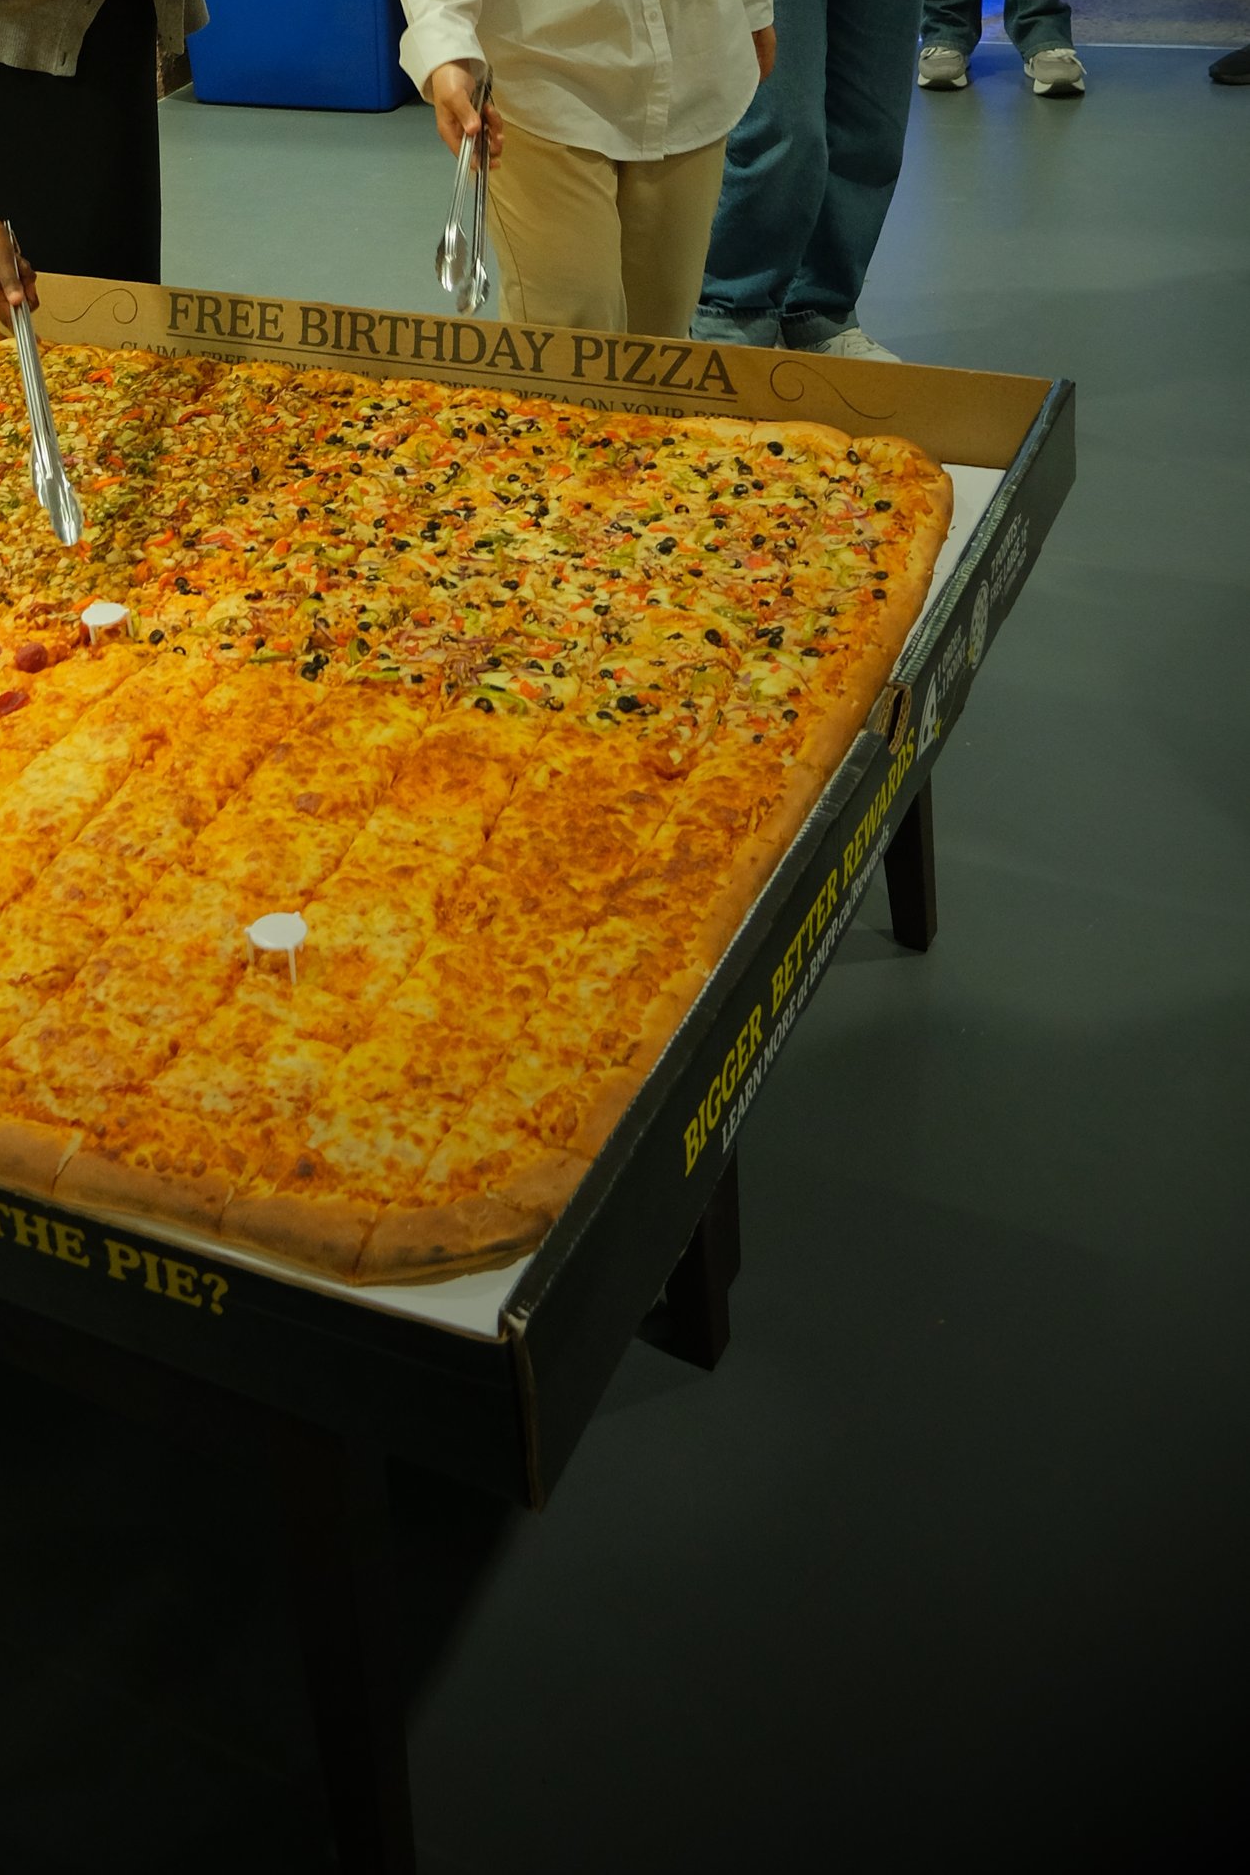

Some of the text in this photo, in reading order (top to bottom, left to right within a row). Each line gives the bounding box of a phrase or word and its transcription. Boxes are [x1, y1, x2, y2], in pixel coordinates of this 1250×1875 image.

[168, 291, 740, 396] FREE BIRTHDAY PIZZA
[682, 726, 916, 1178] BIGGER BETTER REWARDS
[721, 1059, 762, 1155] LEARN
[762, 993, 797, 1075] MORE
[796, 978, 810, 1009] at
[103, 1237, 230, 1317] PIE?
